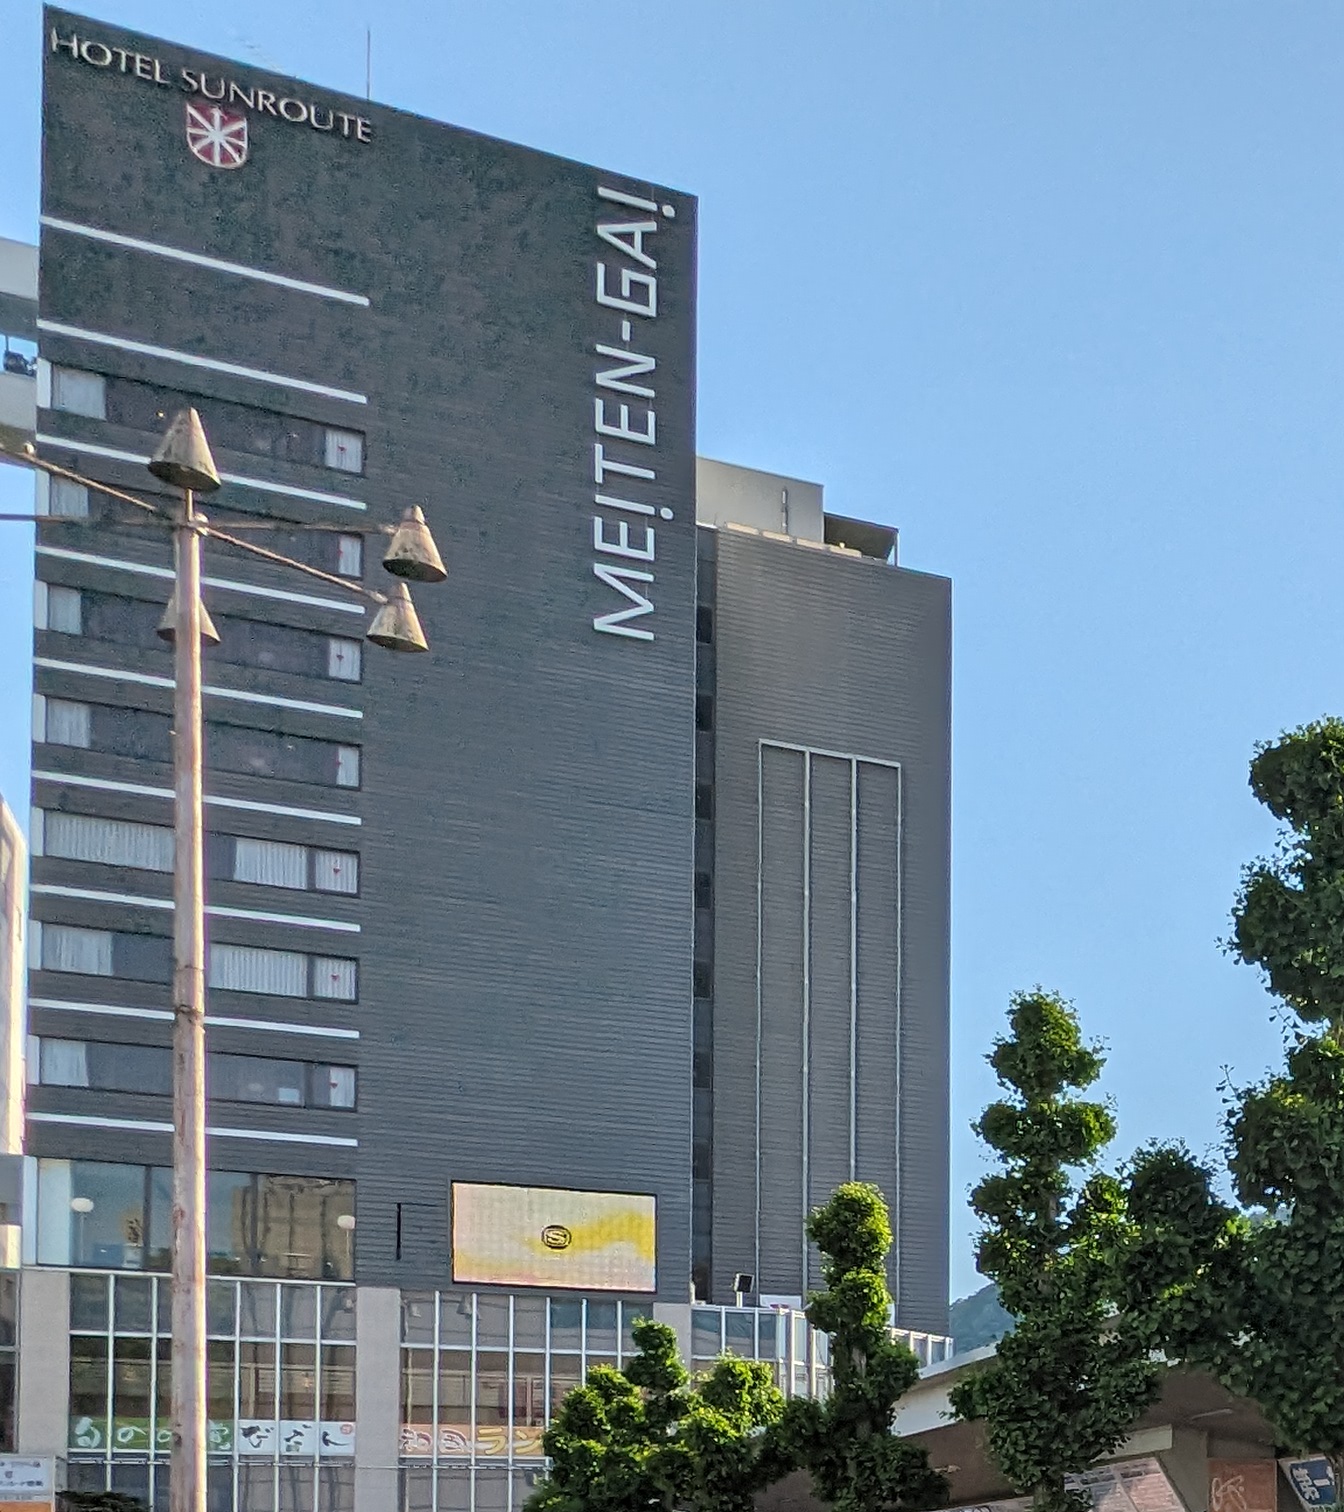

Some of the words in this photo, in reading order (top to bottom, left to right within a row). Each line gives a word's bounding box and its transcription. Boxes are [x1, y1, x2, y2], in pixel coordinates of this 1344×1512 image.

[51, 26, 170, 84] HOTEL
[181, 67, 372, 143] SUNROUTE
[593, 186, 675, 641] MEITEN-GA!
